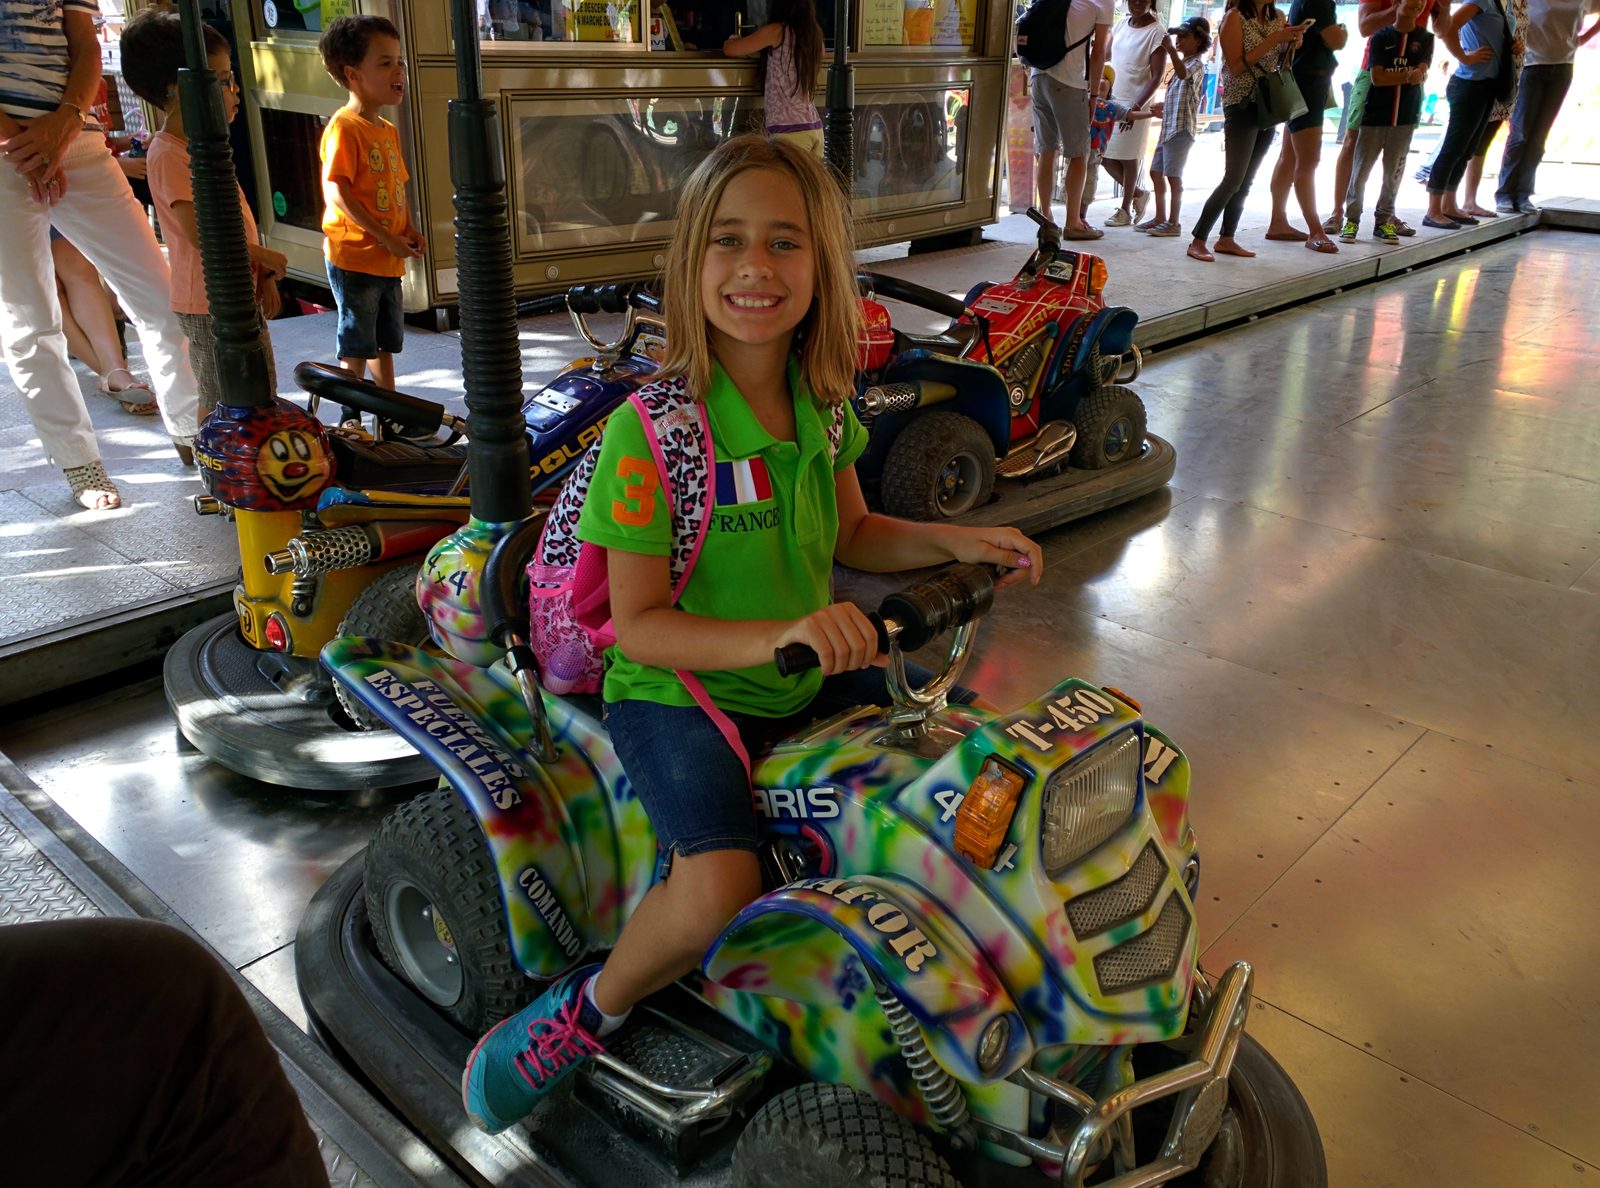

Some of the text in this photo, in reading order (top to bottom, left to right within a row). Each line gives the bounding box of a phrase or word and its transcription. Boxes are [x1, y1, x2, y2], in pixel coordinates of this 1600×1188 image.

[611, 455, 659, 527] 3
[707, 506, 780, 533] FRANCE
[364, 668, 522, 810] ESPECIALES
[1005, 689, 1115, 752] T-450
[519, 867, 580, 957] COMANDO
